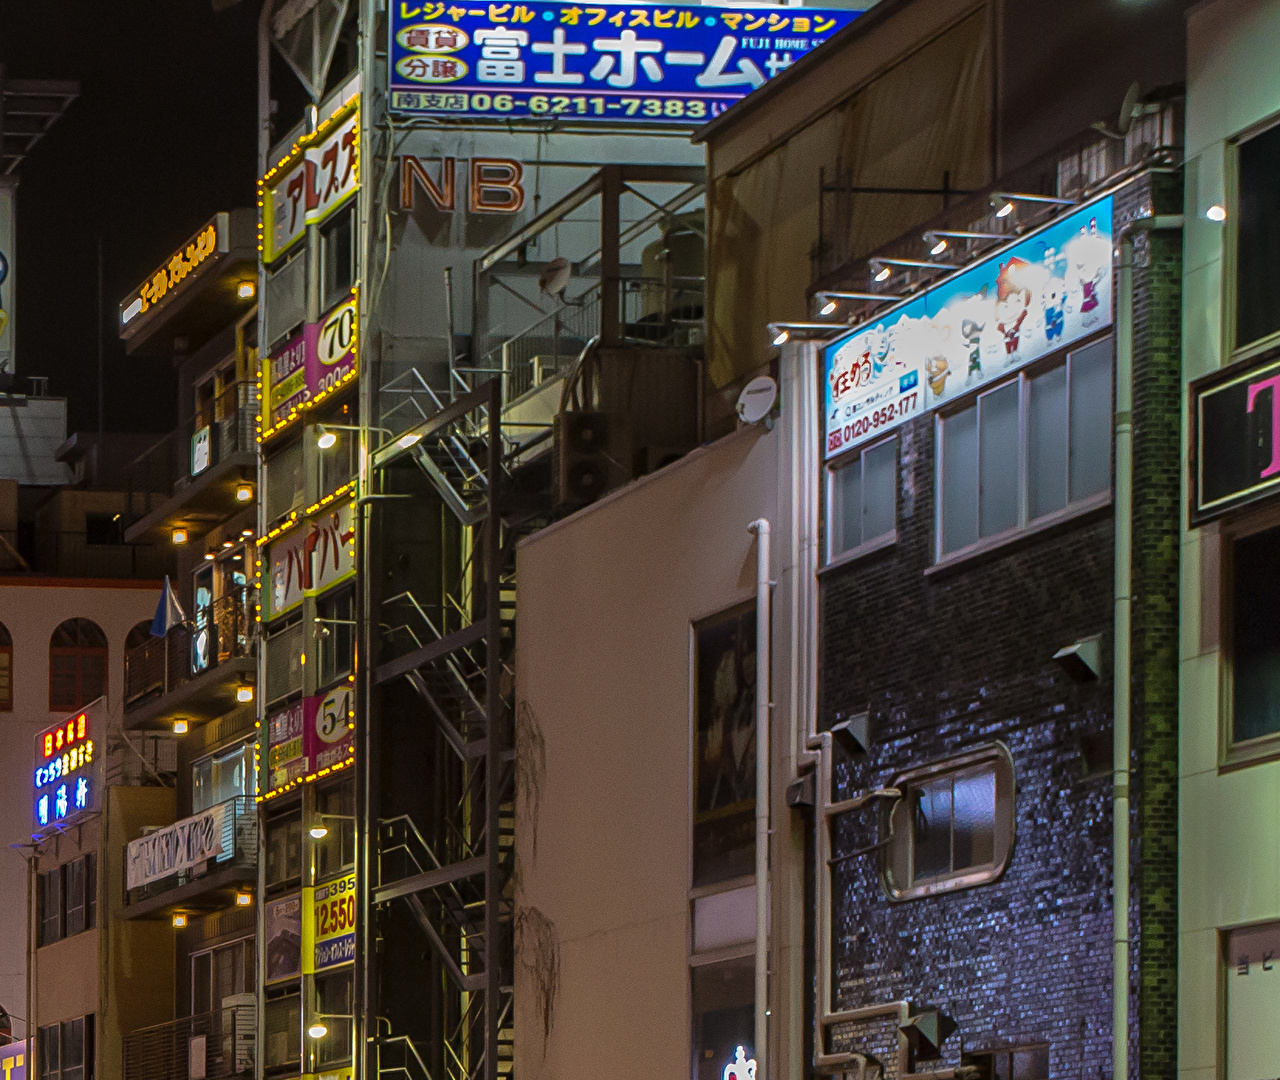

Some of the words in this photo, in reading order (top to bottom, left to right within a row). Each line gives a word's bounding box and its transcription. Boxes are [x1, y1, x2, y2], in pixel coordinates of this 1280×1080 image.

[400, 2, 536, 23] レジャービル
[559, 7, 700, 29] オフィスビル
[720, 11, 837, 34] マンション
[470, 94, 707, 118] 06-6211-7383
[843, 391, 918, 443] 0120-952-177
